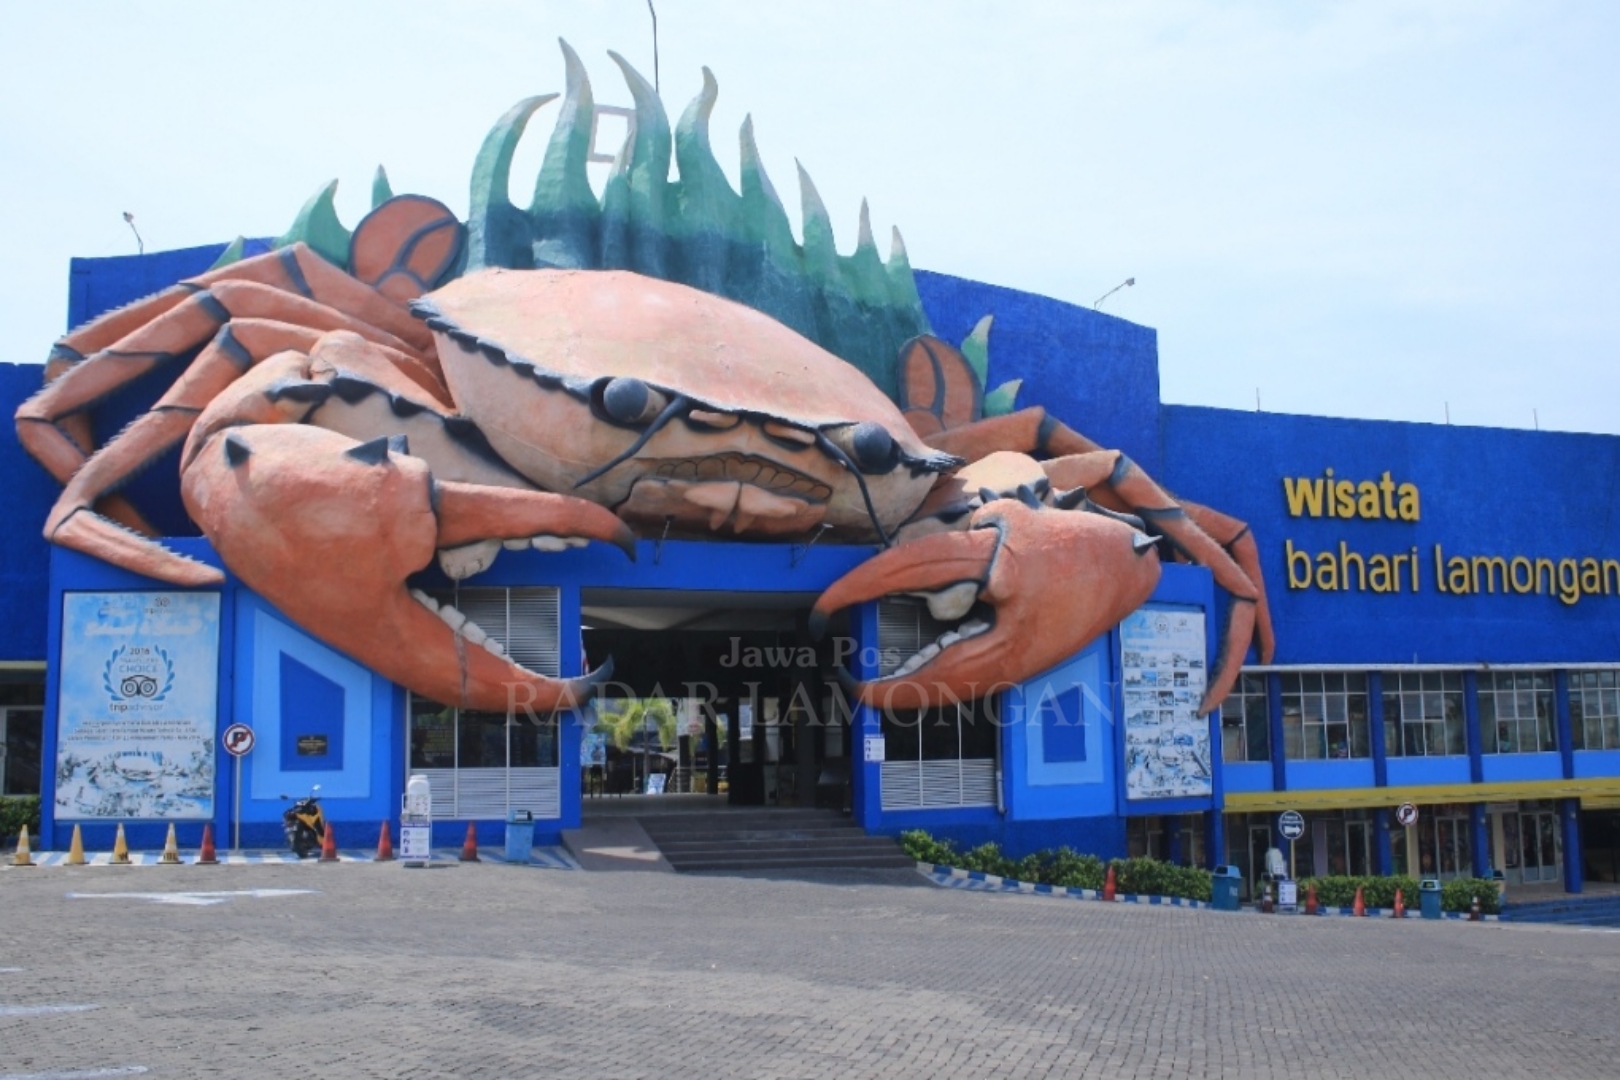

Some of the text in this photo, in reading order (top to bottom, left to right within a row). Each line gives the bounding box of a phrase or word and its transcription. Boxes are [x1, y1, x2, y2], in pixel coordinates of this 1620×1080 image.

[1283, 467, 1420, 521] wisata
[1286, 539, 1620, 605] bahari lamongan
[109, 702, 164, 713] tripadvisor
